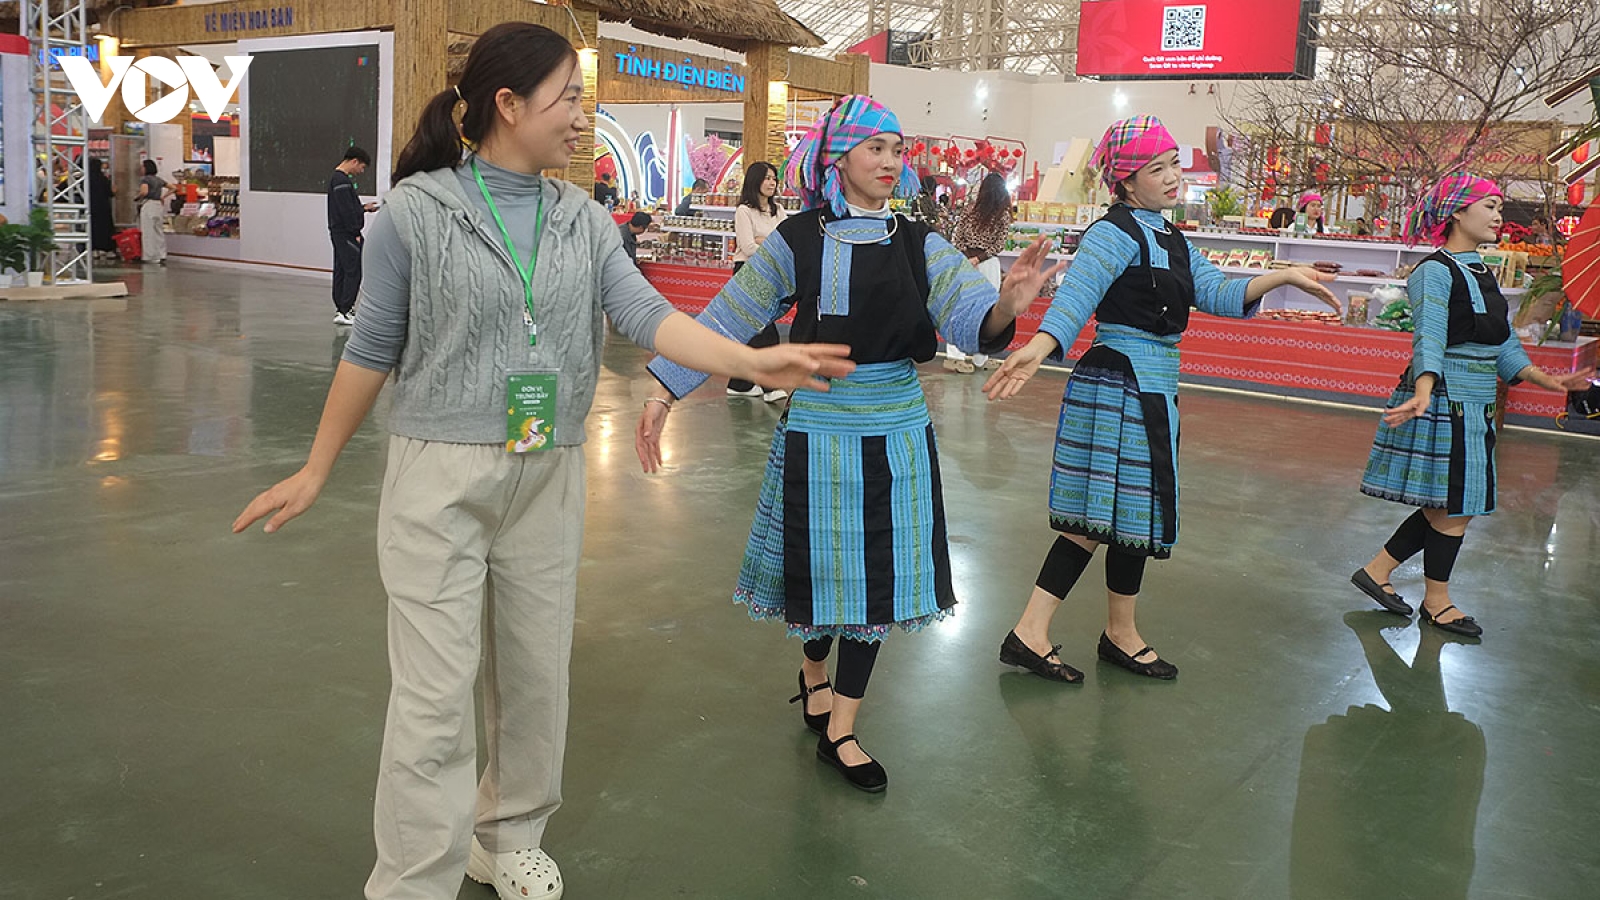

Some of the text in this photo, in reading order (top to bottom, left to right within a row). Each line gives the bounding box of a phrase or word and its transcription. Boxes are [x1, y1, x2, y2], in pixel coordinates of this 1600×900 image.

[249, 10, 268, 30] HOA
[271, 7, 293, 28] BAN
[615, 45, 745, 93] TỈNH ĐIỆN BIÊN
